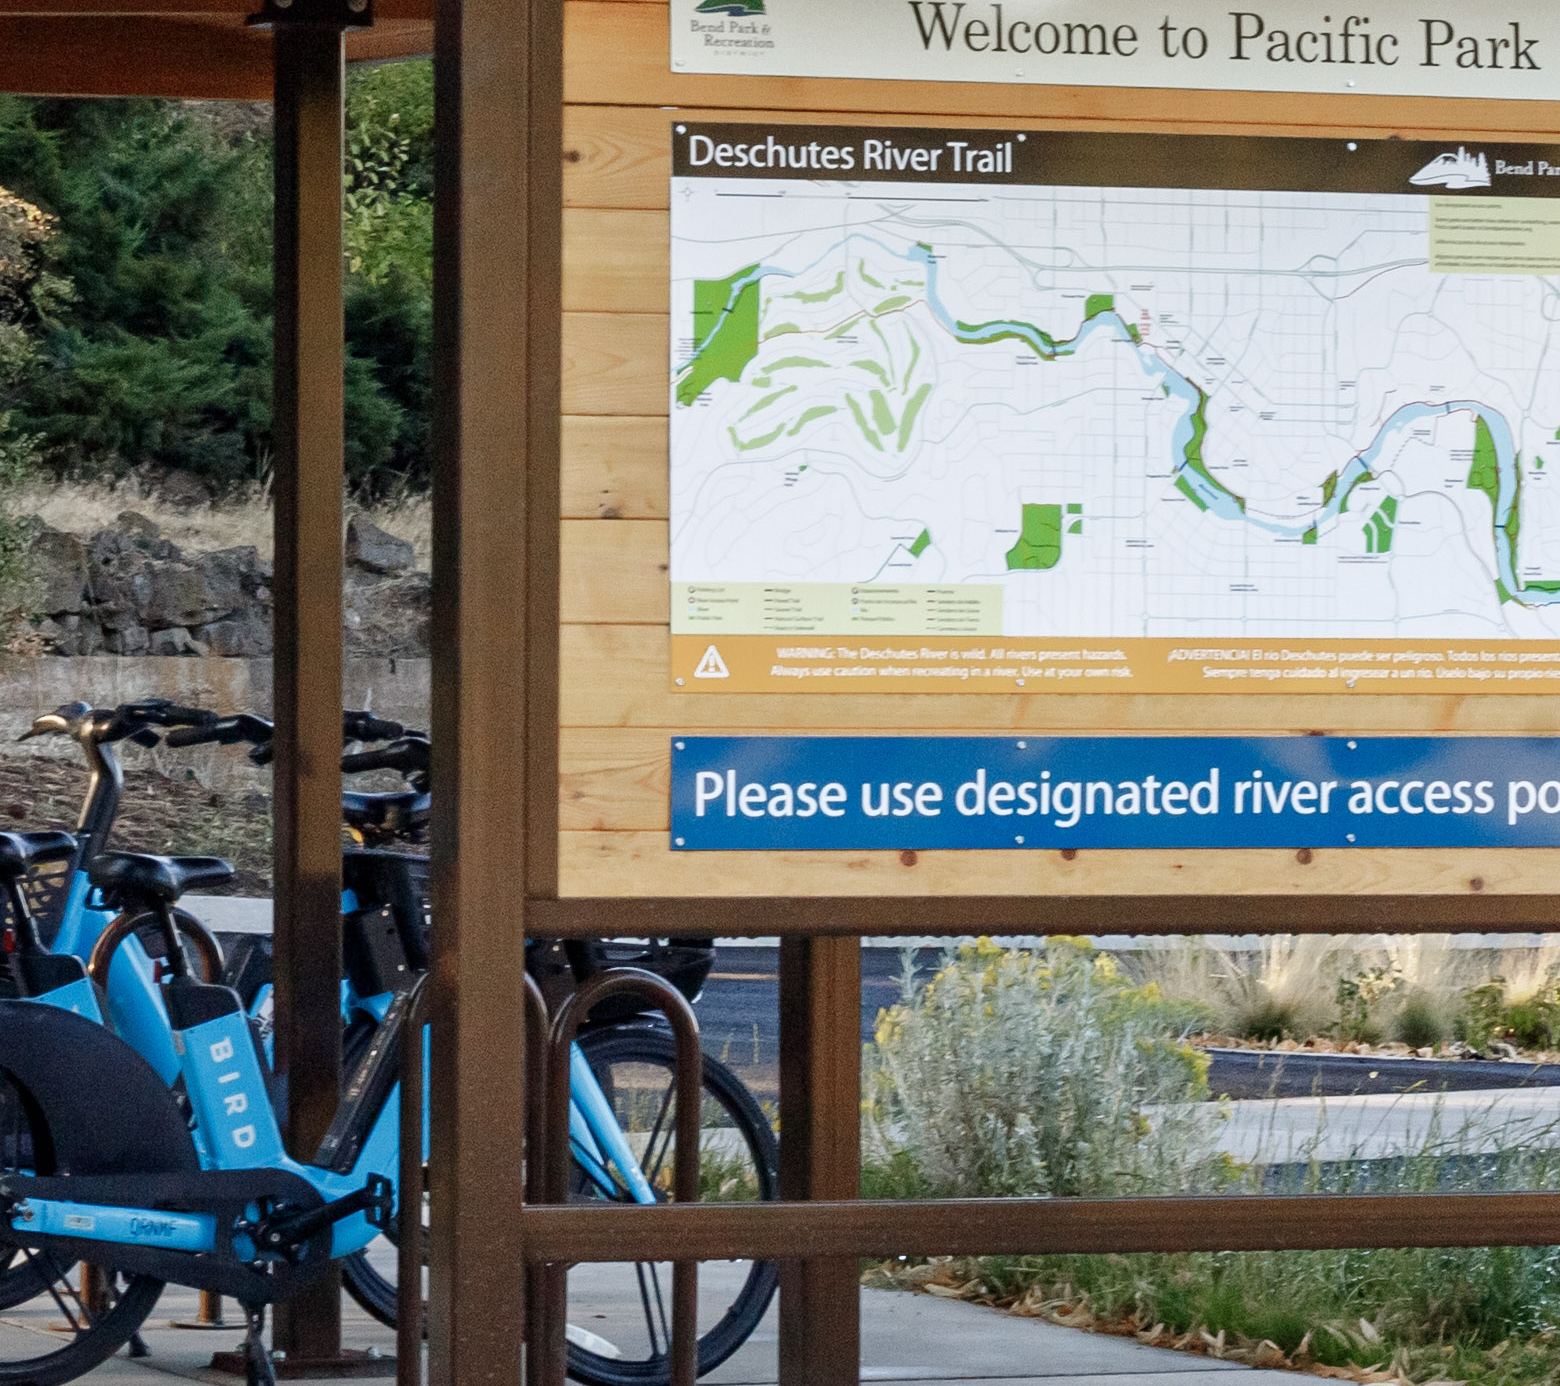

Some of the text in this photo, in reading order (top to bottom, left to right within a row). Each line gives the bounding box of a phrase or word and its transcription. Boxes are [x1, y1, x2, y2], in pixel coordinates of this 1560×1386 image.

[691, 19, 724, 33] Bend
[730, 20, 757, 34] Park
[908, 1, 1542, 70] Welcome to Pacific Park
[704, 34, 774, 49] Recreation
[688, 133, 1013, 173] Deschutes River Trail
[1495, 159, 1533, 176] Bend
[859, 647, 919, 660] Deschutes
[696, 770, 846, 816] Please
[862, 783, 942, 816] use
[956, 768, 1218, 827] designated
[1235, 771, 1337, 814] river
[1349, 781, 1494, 814] access
[210, 1036, 257, 1148] BIRD
